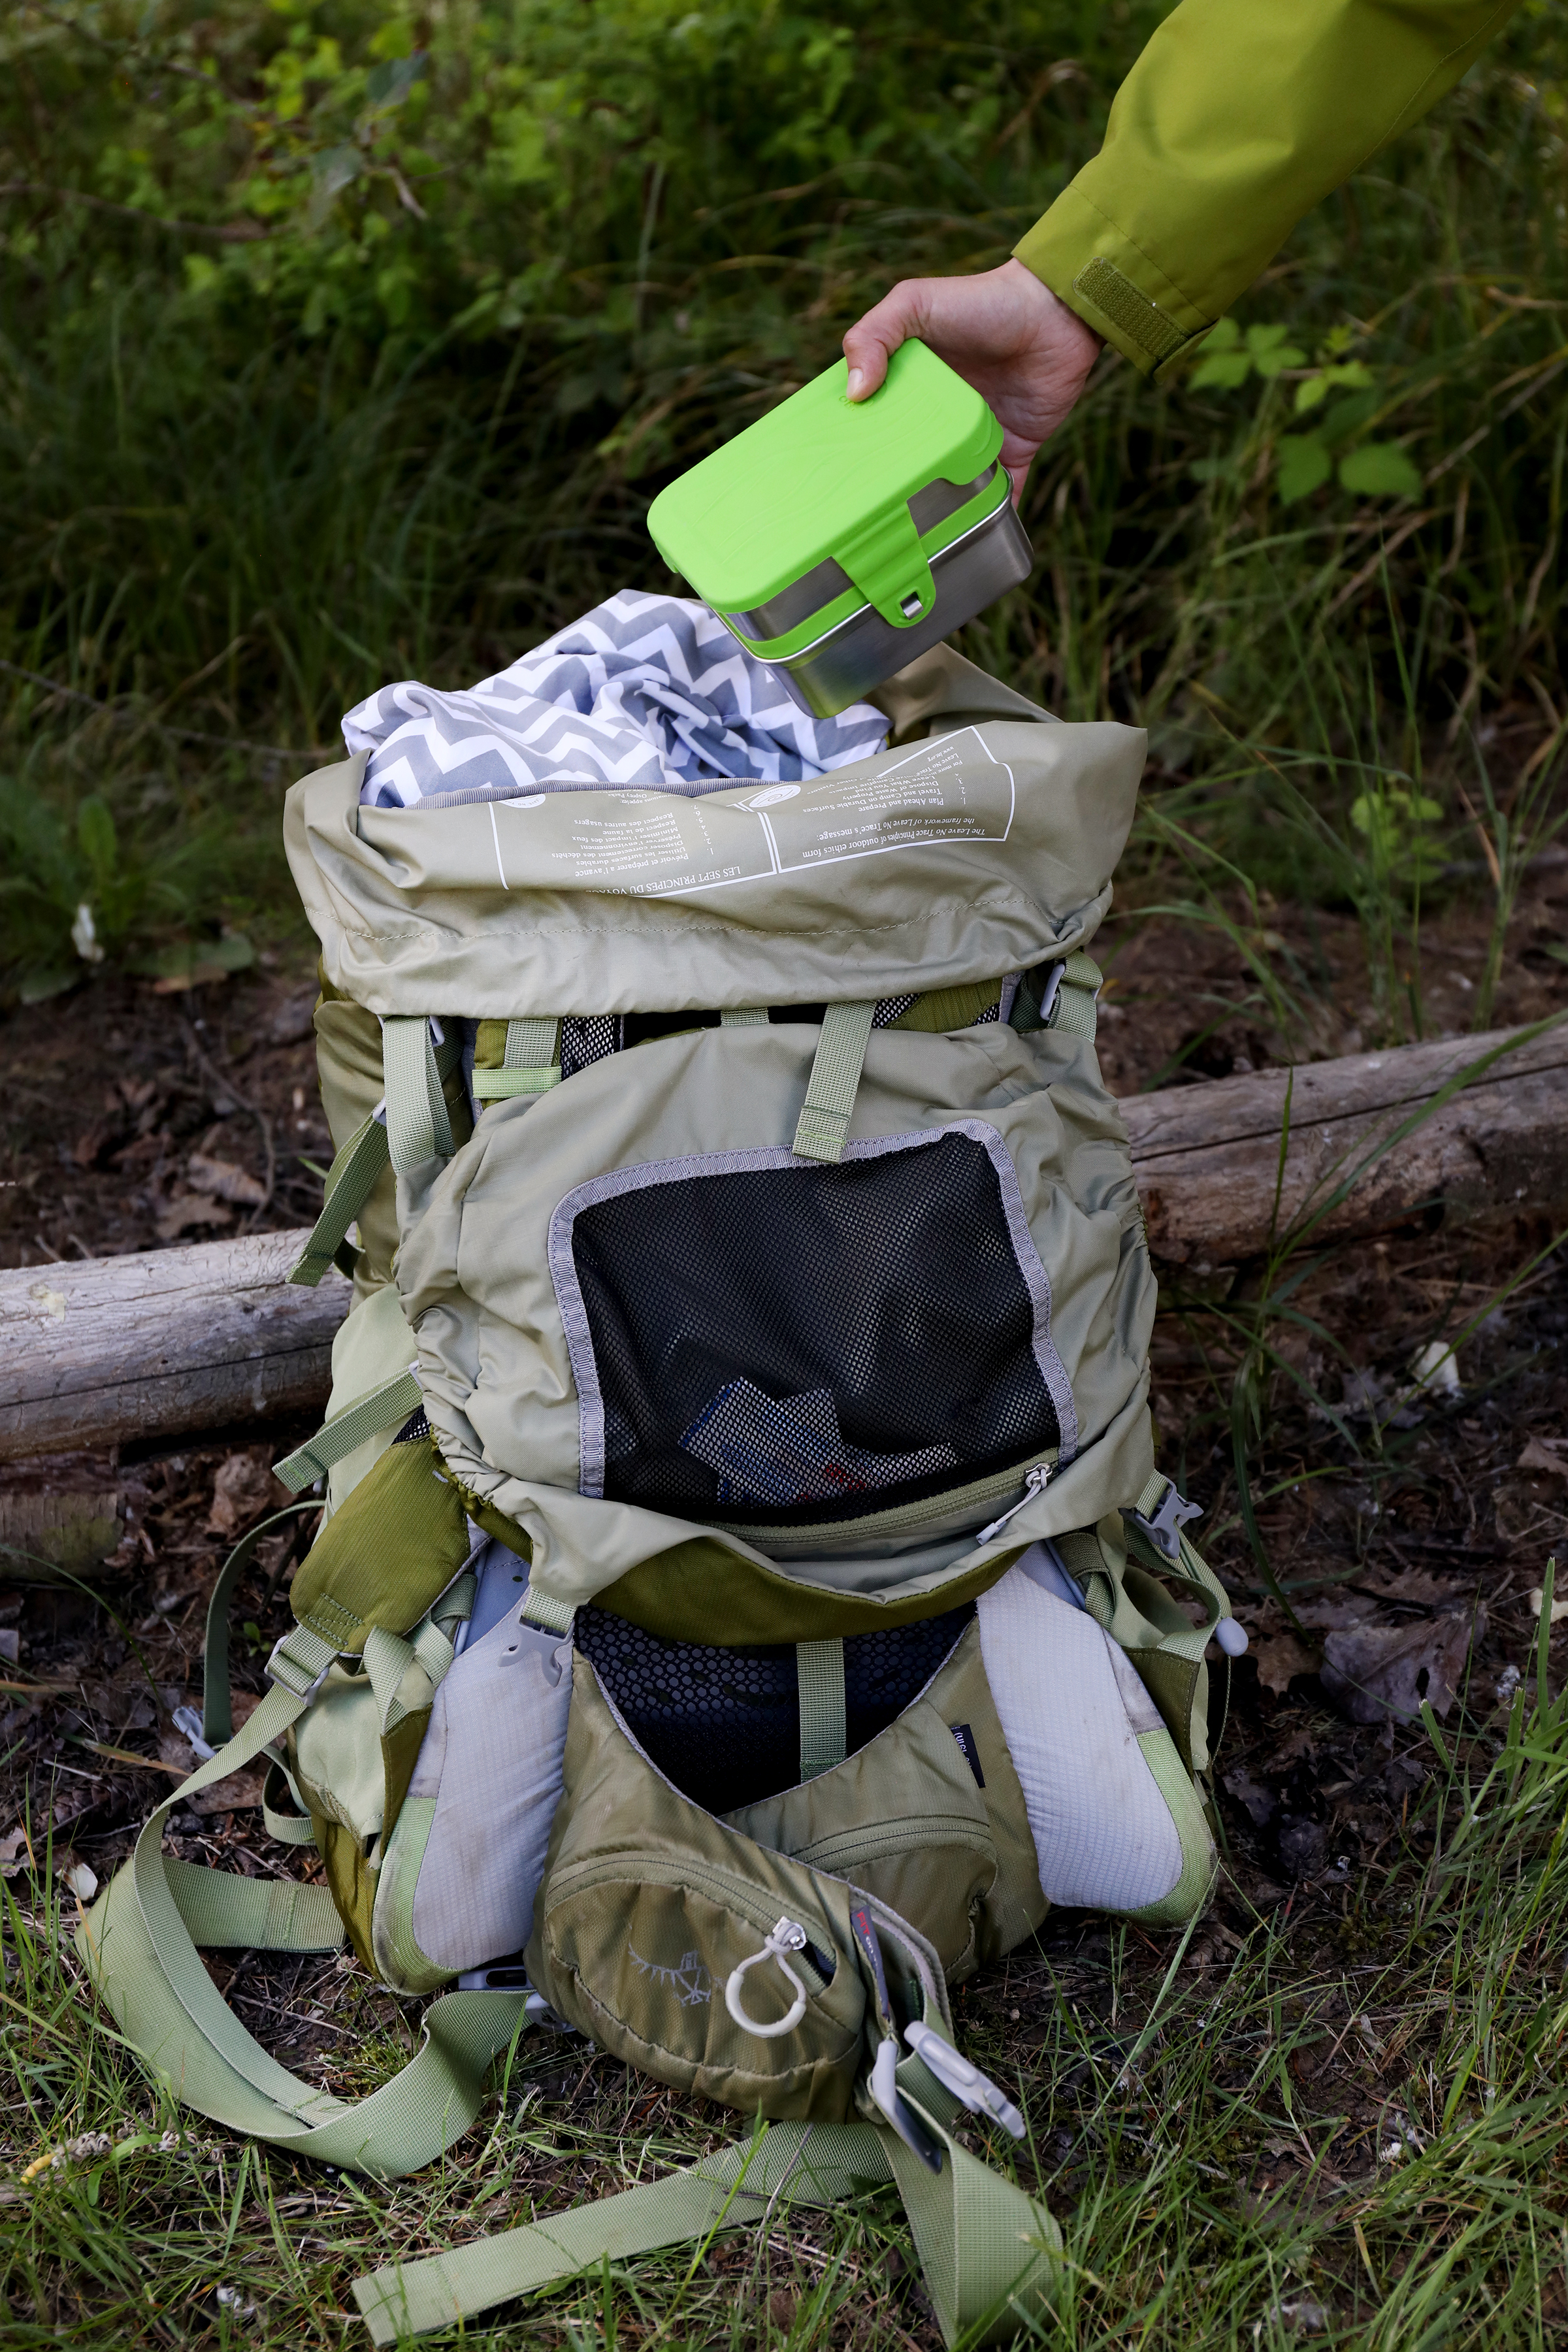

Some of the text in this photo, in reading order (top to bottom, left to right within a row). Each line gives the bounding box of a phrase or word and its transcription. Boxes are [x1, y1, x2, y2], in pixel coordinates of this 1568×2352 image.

[941, 753, 959, 763] Leave
[916, 766, 933, 776] Trace
[938, 764, 952, 773] more
[807, 784, 835, 794] Visitors
[828, 785, 858, 794] Impacts
[842, 792, 874, 800] Properly
[802, 804, 835, 813] Surfaces
[836, 799, 866, 808] Durable
[858, 803, 887, 812] Prepare
[644, 812, 674, 825] Respect
[893, 819, 913, 827] Leave
[645, 819, 676, 831] Respect
[883, 821, 892, 830] No
[640, 826, 678, 838] Minimiser
[816, 828, 853, 841] message:
[887, 831, 915, 842] Principles
[645, 833, 681, 844] Préserver
[849, 838, 879, 848] outdoor
[881, 836, 887, 844] of
[649, 840, 683, 849] Disposer
[824, 843, 847, 854] ethics
[598, 845, 647, 857] correctement
[658, 847, 686, 856] Utiliser
[802, 849, 821, 858] form
[611, 853, 642, 863] surfaces
[660, 853, 689, 864] Prévoir
[617, 860, 649, 872] préparer
[698, 870, 721, 882] SEPT
[723, 866, 741, 877] LES
[646, 875, 696, 892] PRINCIPES
[629, 884, 644, 894] DU
[857, 1911, 870, 1936] FIT
